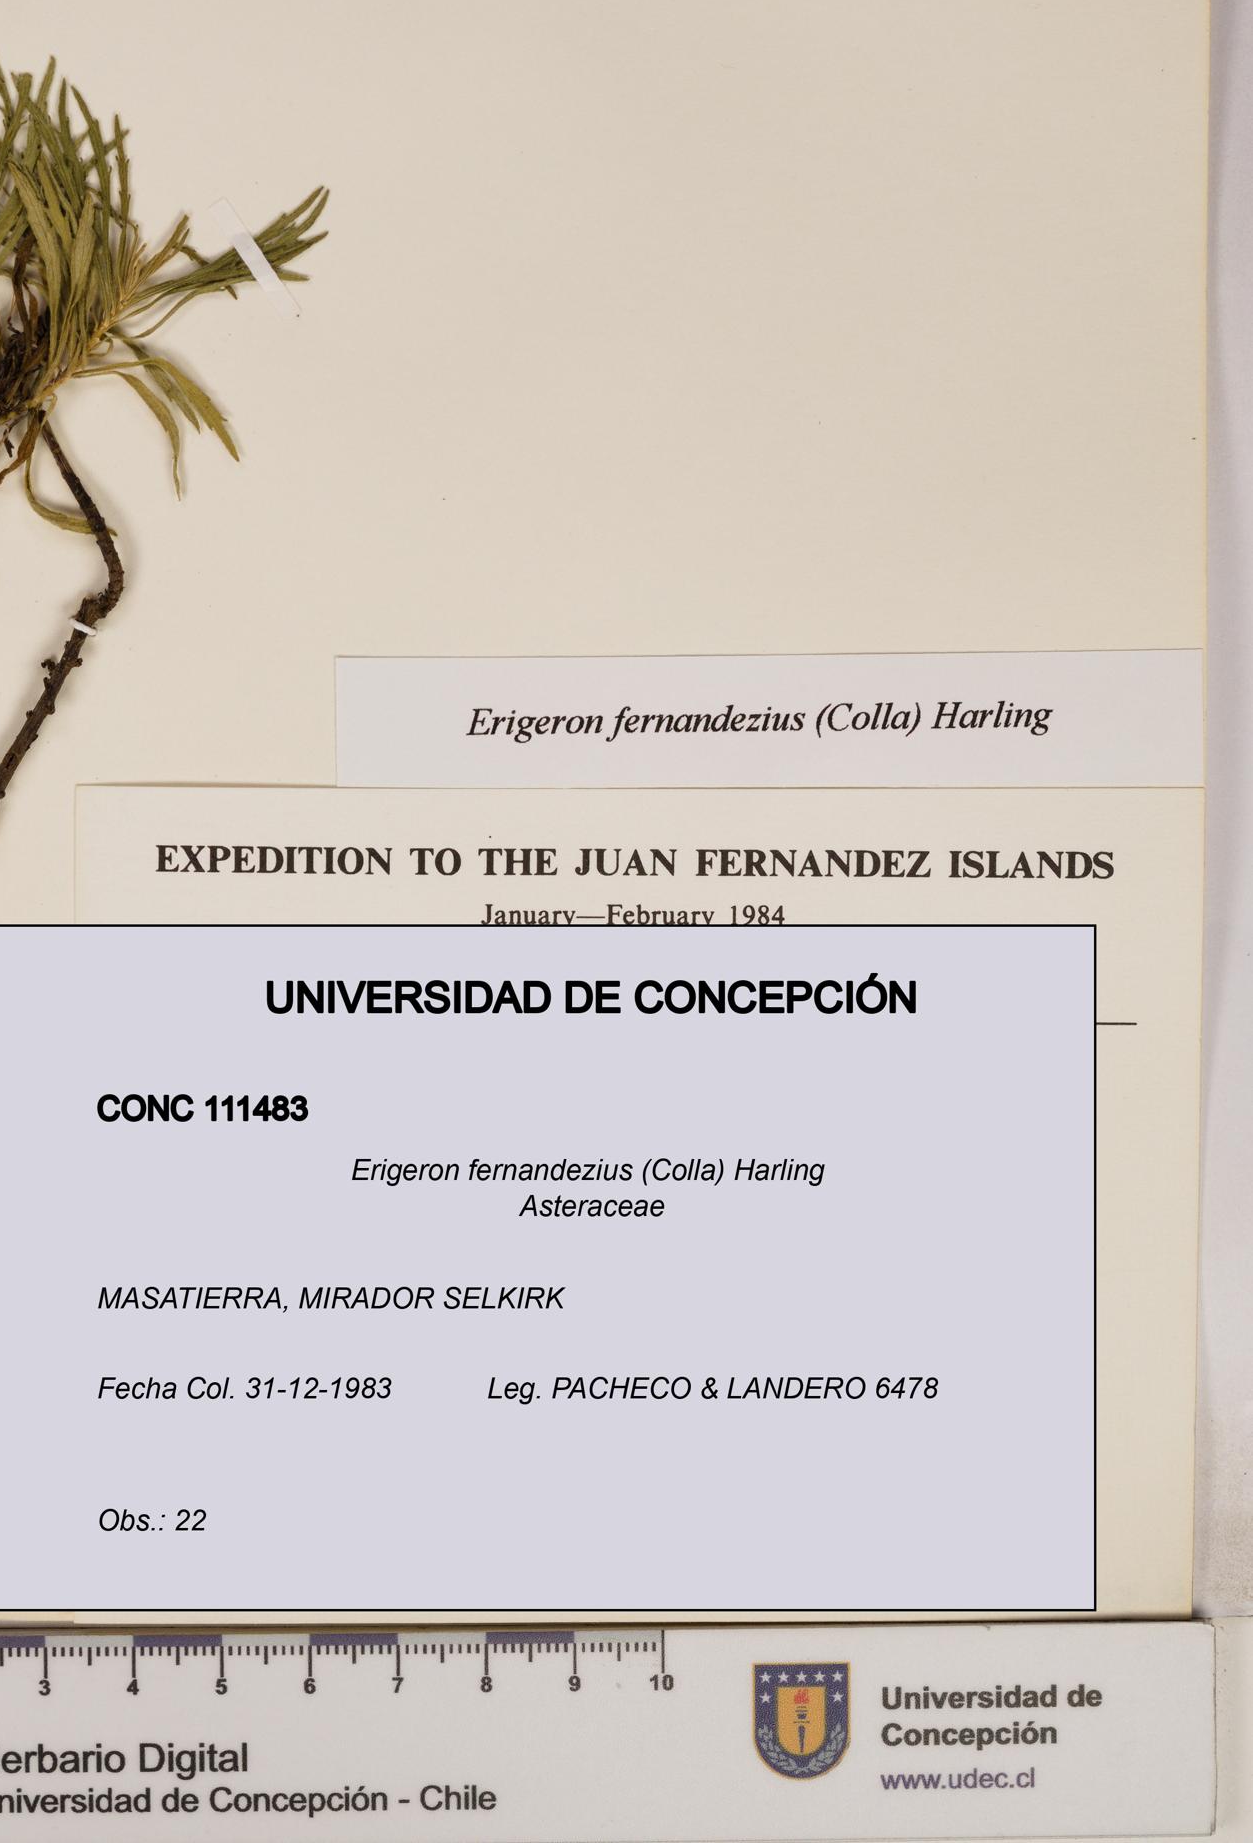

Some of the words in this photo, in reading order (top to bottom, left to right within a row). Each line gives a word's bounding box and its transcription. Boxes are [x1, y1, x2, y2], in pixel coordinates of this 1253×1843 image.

[465, 707, 604, 744] Erigeron
[605, 703, 806, 744] fernandezius
[815, 701, 922, 739] (Colla)
[930, 700, 1054, 737] Harling
[155, 844, 393, 876] EXPEDITION
[409, 847, 462, 876] TO
[477, 847, 558, 876] THE
[574, 848, 678, 877] JUAN
[695, 848, 932, 878] FERNANDEZ
[948, 850, 1115, 880] ISLANDS
[730, 904, 786, 925] 1984
[38, 1678, 52, 1697] 3
[126, 1677, 140, 1696] 4
[214, 1677, 228, 1696] 5
[303, 1676, 317, 1695] 6
[391, 1675, 405, 1694] 7
[480, 1674, 493, 1693] 8
[567, 1674, 582, 1693] 9
[649, 1673, 674, 1692] 10
[882, 1684, 1058, 1711] Universidad
[1066, 1683, 1103, 1708] de
[880, 1720, 1058, 1751] Concepción
[139, 1742, 248, 1779] Digital
[880, 1767, 1036, 1791] www.udec.cl
[161, 1786, 200, 1814] de
[209, 1785, 388, 1819] Concepción
[419, 1784, 497, 1812] Chile
